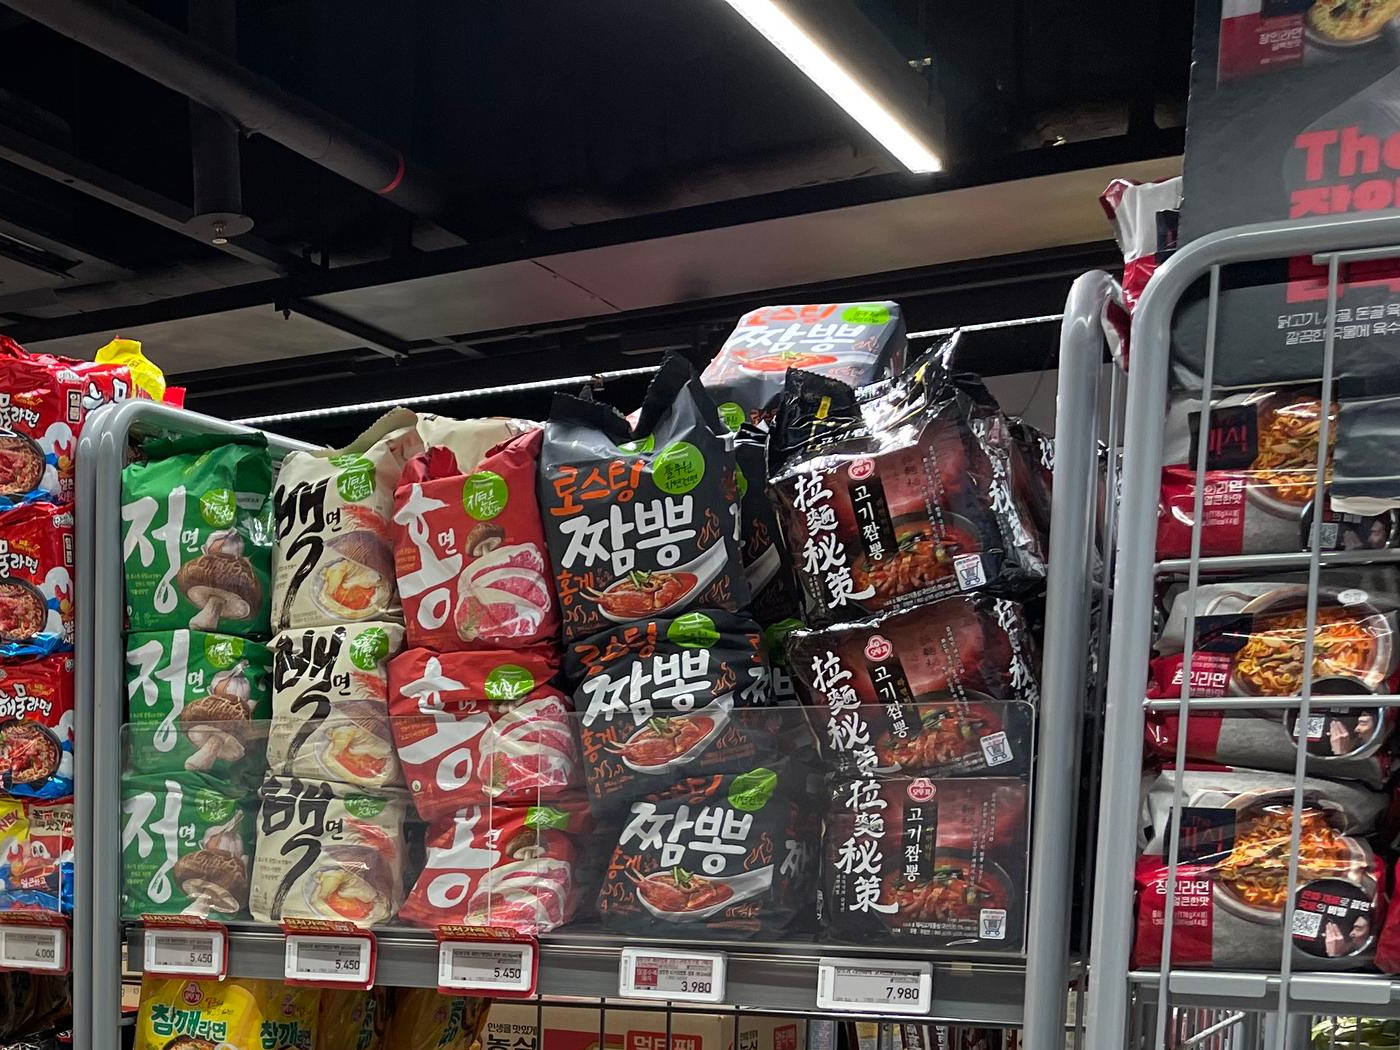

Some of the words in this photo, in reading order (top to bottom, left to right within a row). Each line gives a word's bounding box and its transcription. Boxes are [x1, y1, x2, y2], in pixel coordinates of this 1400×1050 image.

[727, 324, 867, 353] 짬뽕
[551, 459, 645, 516] 로스팅
[559, 495, 696, 577] 짬뽕
[793, 471, 875, 609] 拉麵秘策
[854, 485, 885, 561] 고기짬뽕
[557, 570, 594, 606] 홍게
[582, 649, 712, 727] 짬뽕
[874, 667, 908, 738] 고기짬뽕
[812, 651, 901, 776] 拉麵秘策
[581, 727, 616, 763] 홍게
[620, 802, 753, 874] 짬뽕
[835, 780, 898, 914] 拉麵秘策
[904, 808, 924, 882] 고기짬뽕
[35, 949, 56, 960] 4.000
[189, 953, 213, 965] 5.450
[334, 959, 361, 971] 5.450
[492, 967, 522, 980] 5.450
[681, 981, 712, 994] 3.980
[886, 987, 920, 1001] 7.980
[151, 1003, 228, 1041] 참깨라면
